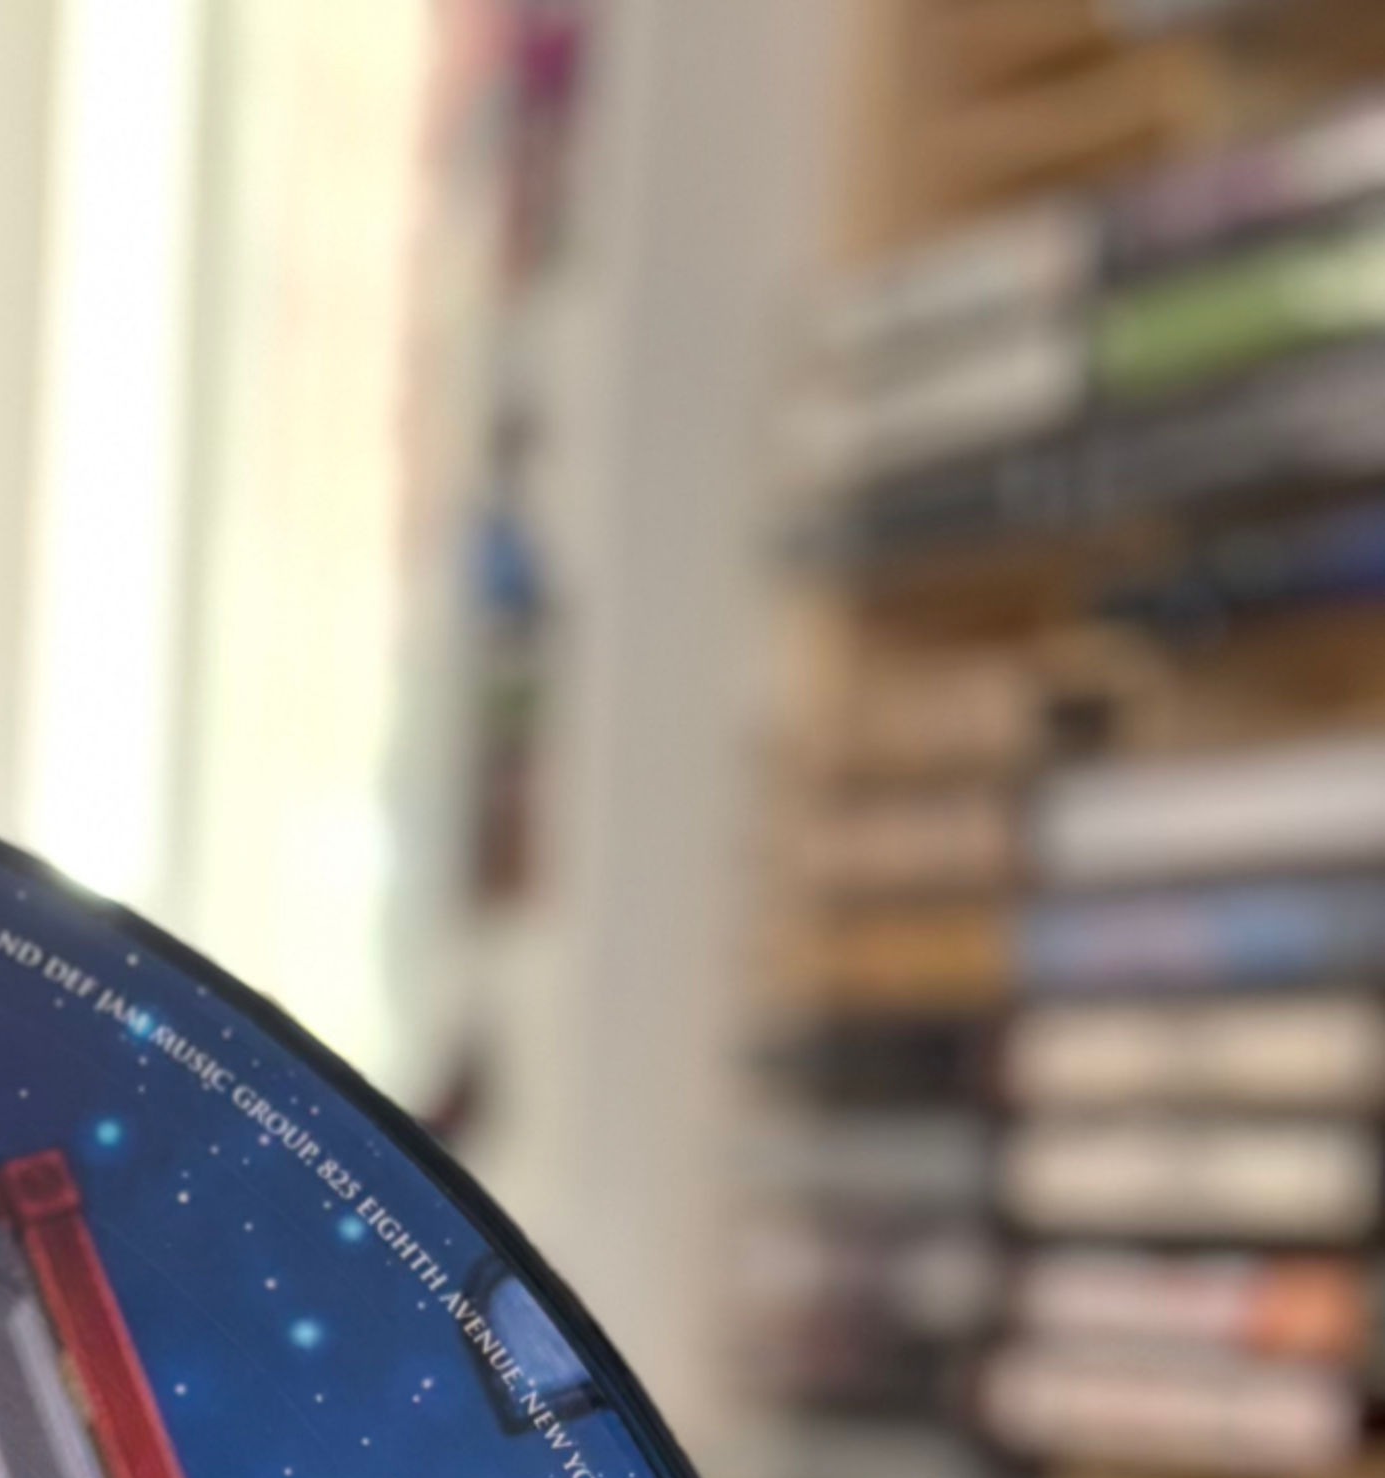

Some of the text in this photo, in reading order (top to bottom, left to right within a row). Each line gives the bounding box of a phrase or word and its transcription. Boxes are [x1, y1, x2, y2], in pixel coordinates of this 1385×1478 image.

[43, 953, 99, 999] DEF
[94, 983, 153, 1036] JAM
[149, 1024, 234, 1093] MUSIC
[315, 1157, 363, 1201] 825
[355, 1195, 448, 1292] EIGHTH
[519, 1390, 573, 1451] NEW
